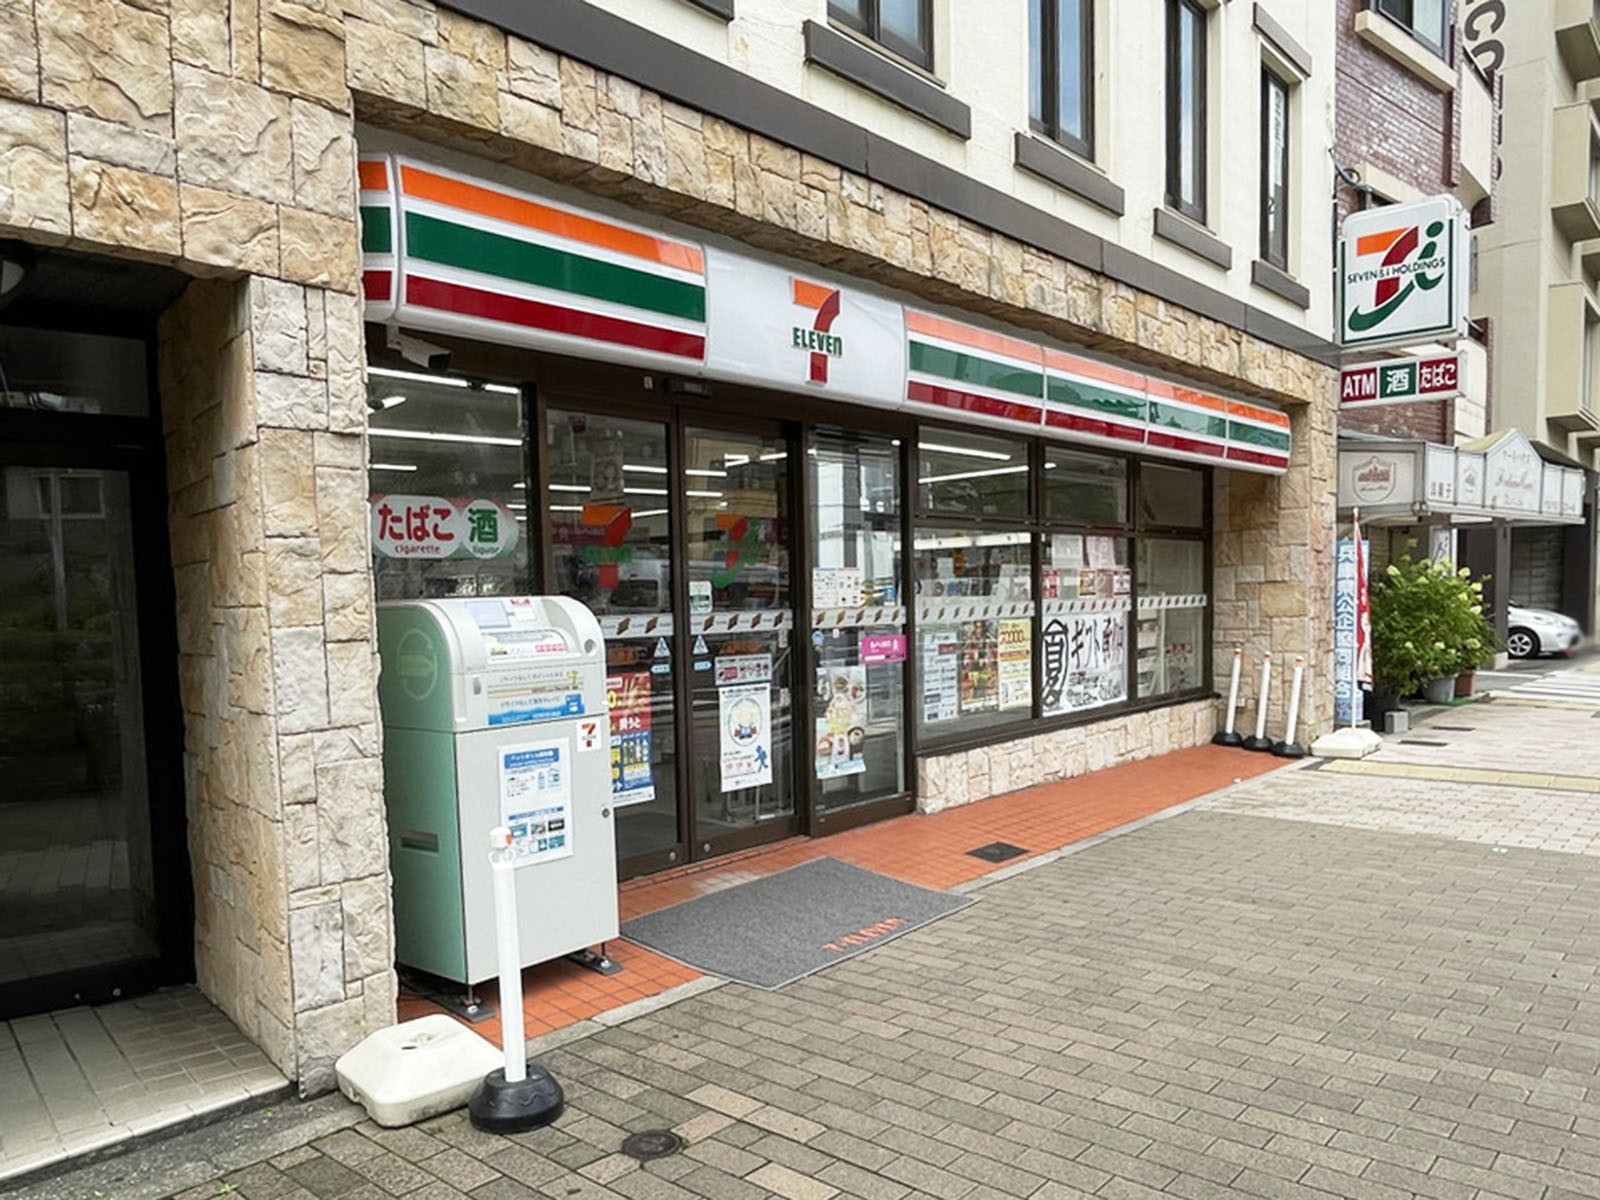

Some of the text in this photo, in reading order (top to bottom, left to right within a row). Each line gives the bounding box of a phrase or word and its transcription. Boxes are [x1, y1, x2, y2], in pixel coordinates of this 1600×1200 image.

[1391, 256, 1446, 275] HOLDINGS
[1343, 374, 1376, 399] ATM
[1385, 369, 1410, 394] 酒
[1419, 362, 1457, 389] たばこ
[377, 503, 499, 543] たばこ 酒
[394, 544, 441, 555] cigarette
